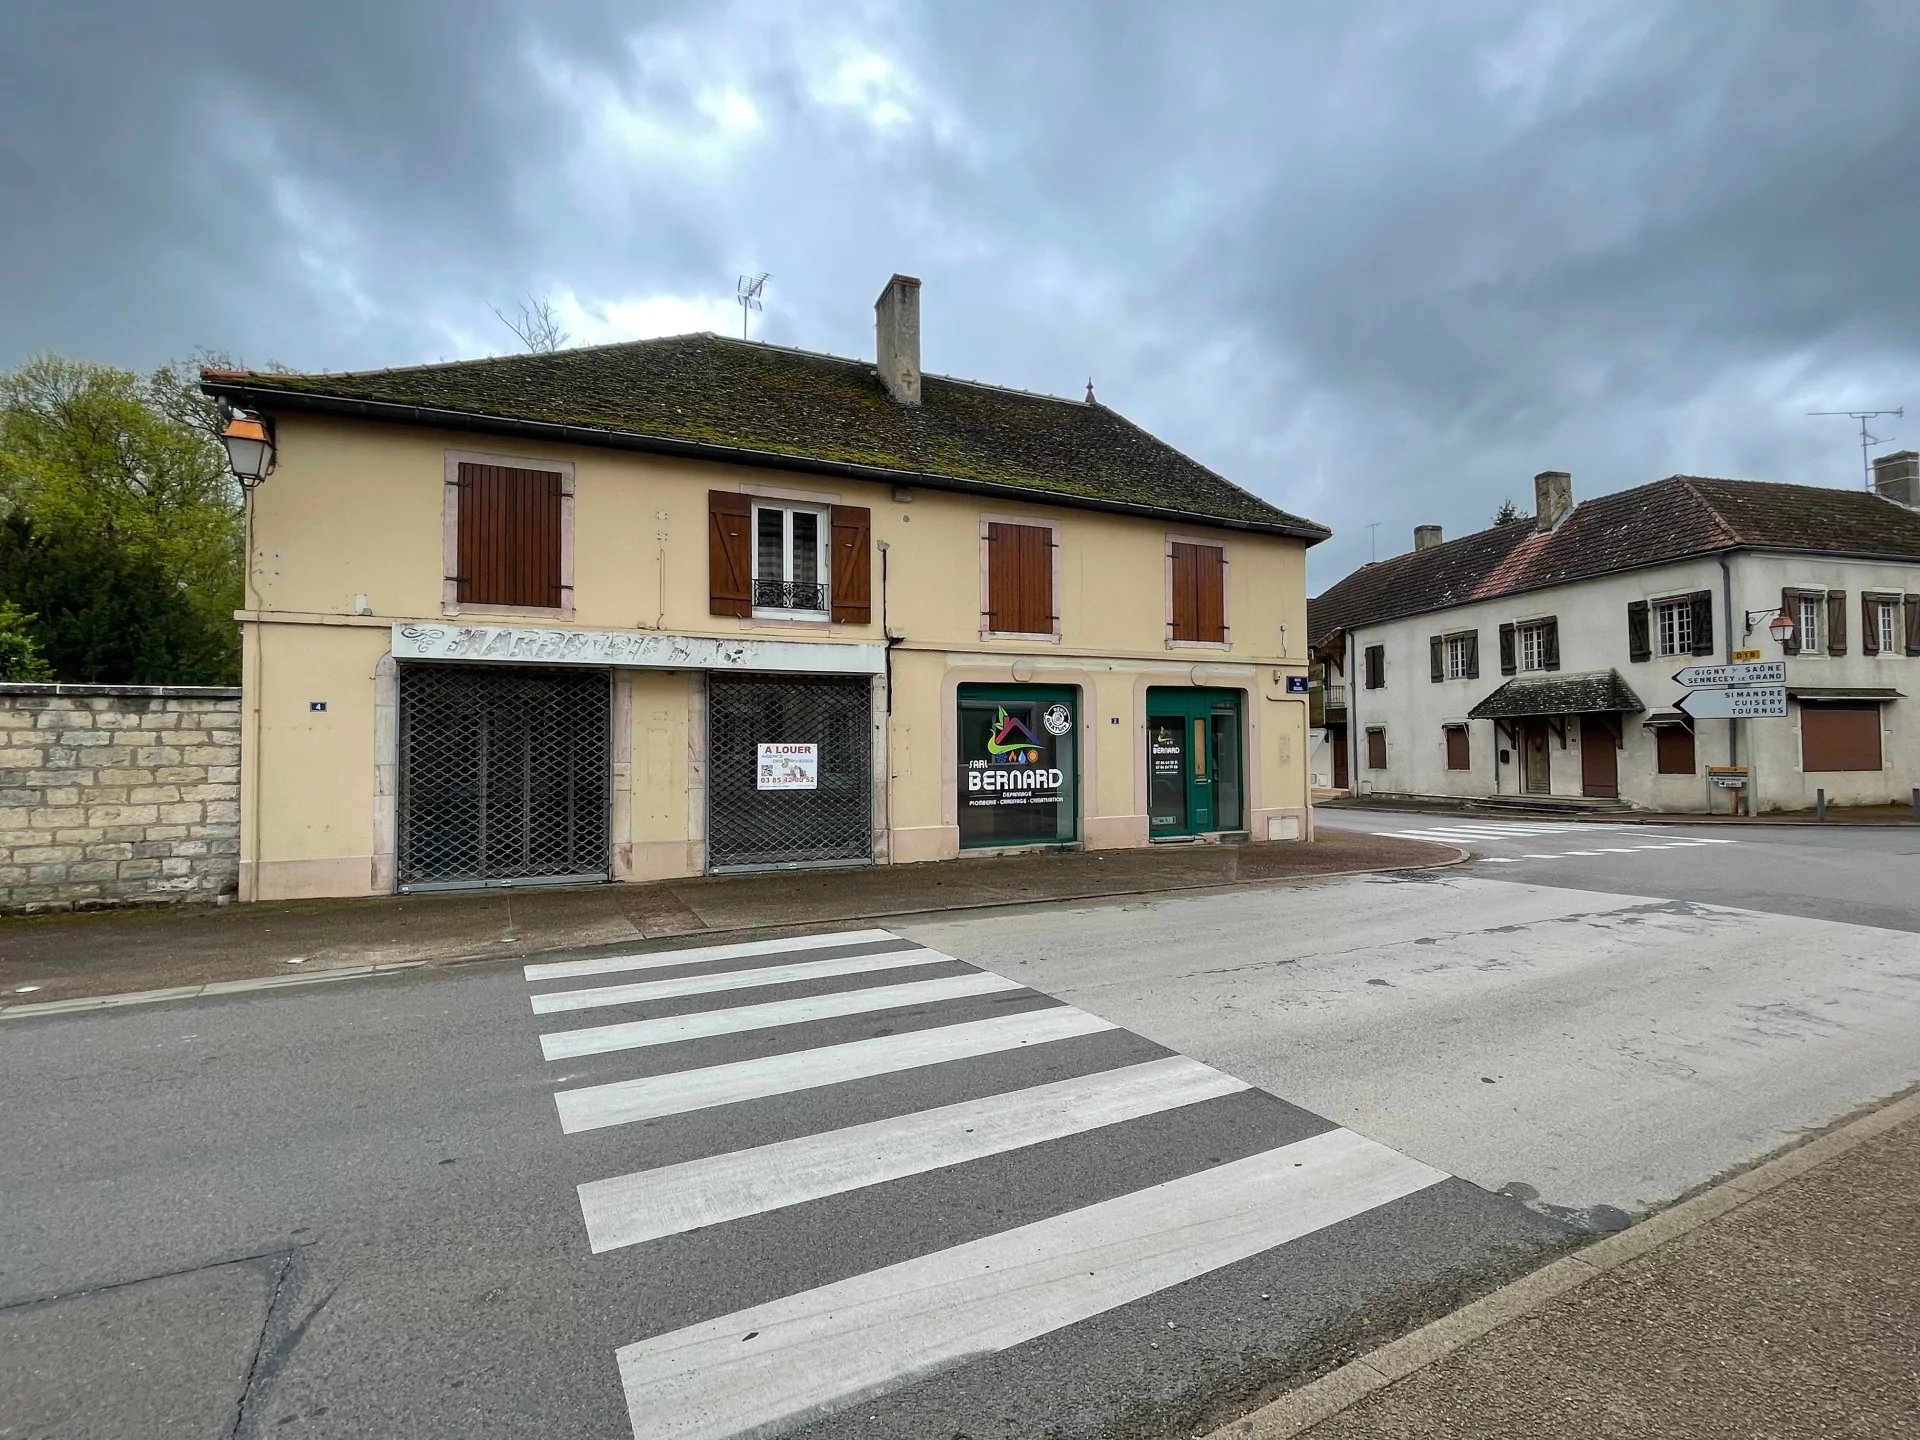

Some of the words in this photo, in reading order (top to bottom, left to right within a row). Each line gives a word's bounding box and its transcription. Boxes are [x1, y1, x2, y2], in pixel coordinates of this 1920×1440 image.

[1736, 651, 1756, 659] D18
[1745, 665, 1782, 673] SAÔNE
[1688, 675, 1735, 684] SENNECEY
[1748, 673, 1782, 681] GRAND
[1724, 690, 1782, 698] SIMANDRE
[1731, 707, 1784, 715] TOURNUS
[1046, 717, 1068, 732] GRATUIT
[776, 746, 811, 754] LOUER
[969, 760, 988, 769] SARL
[968, 769, 1063, 791] BERNARD
